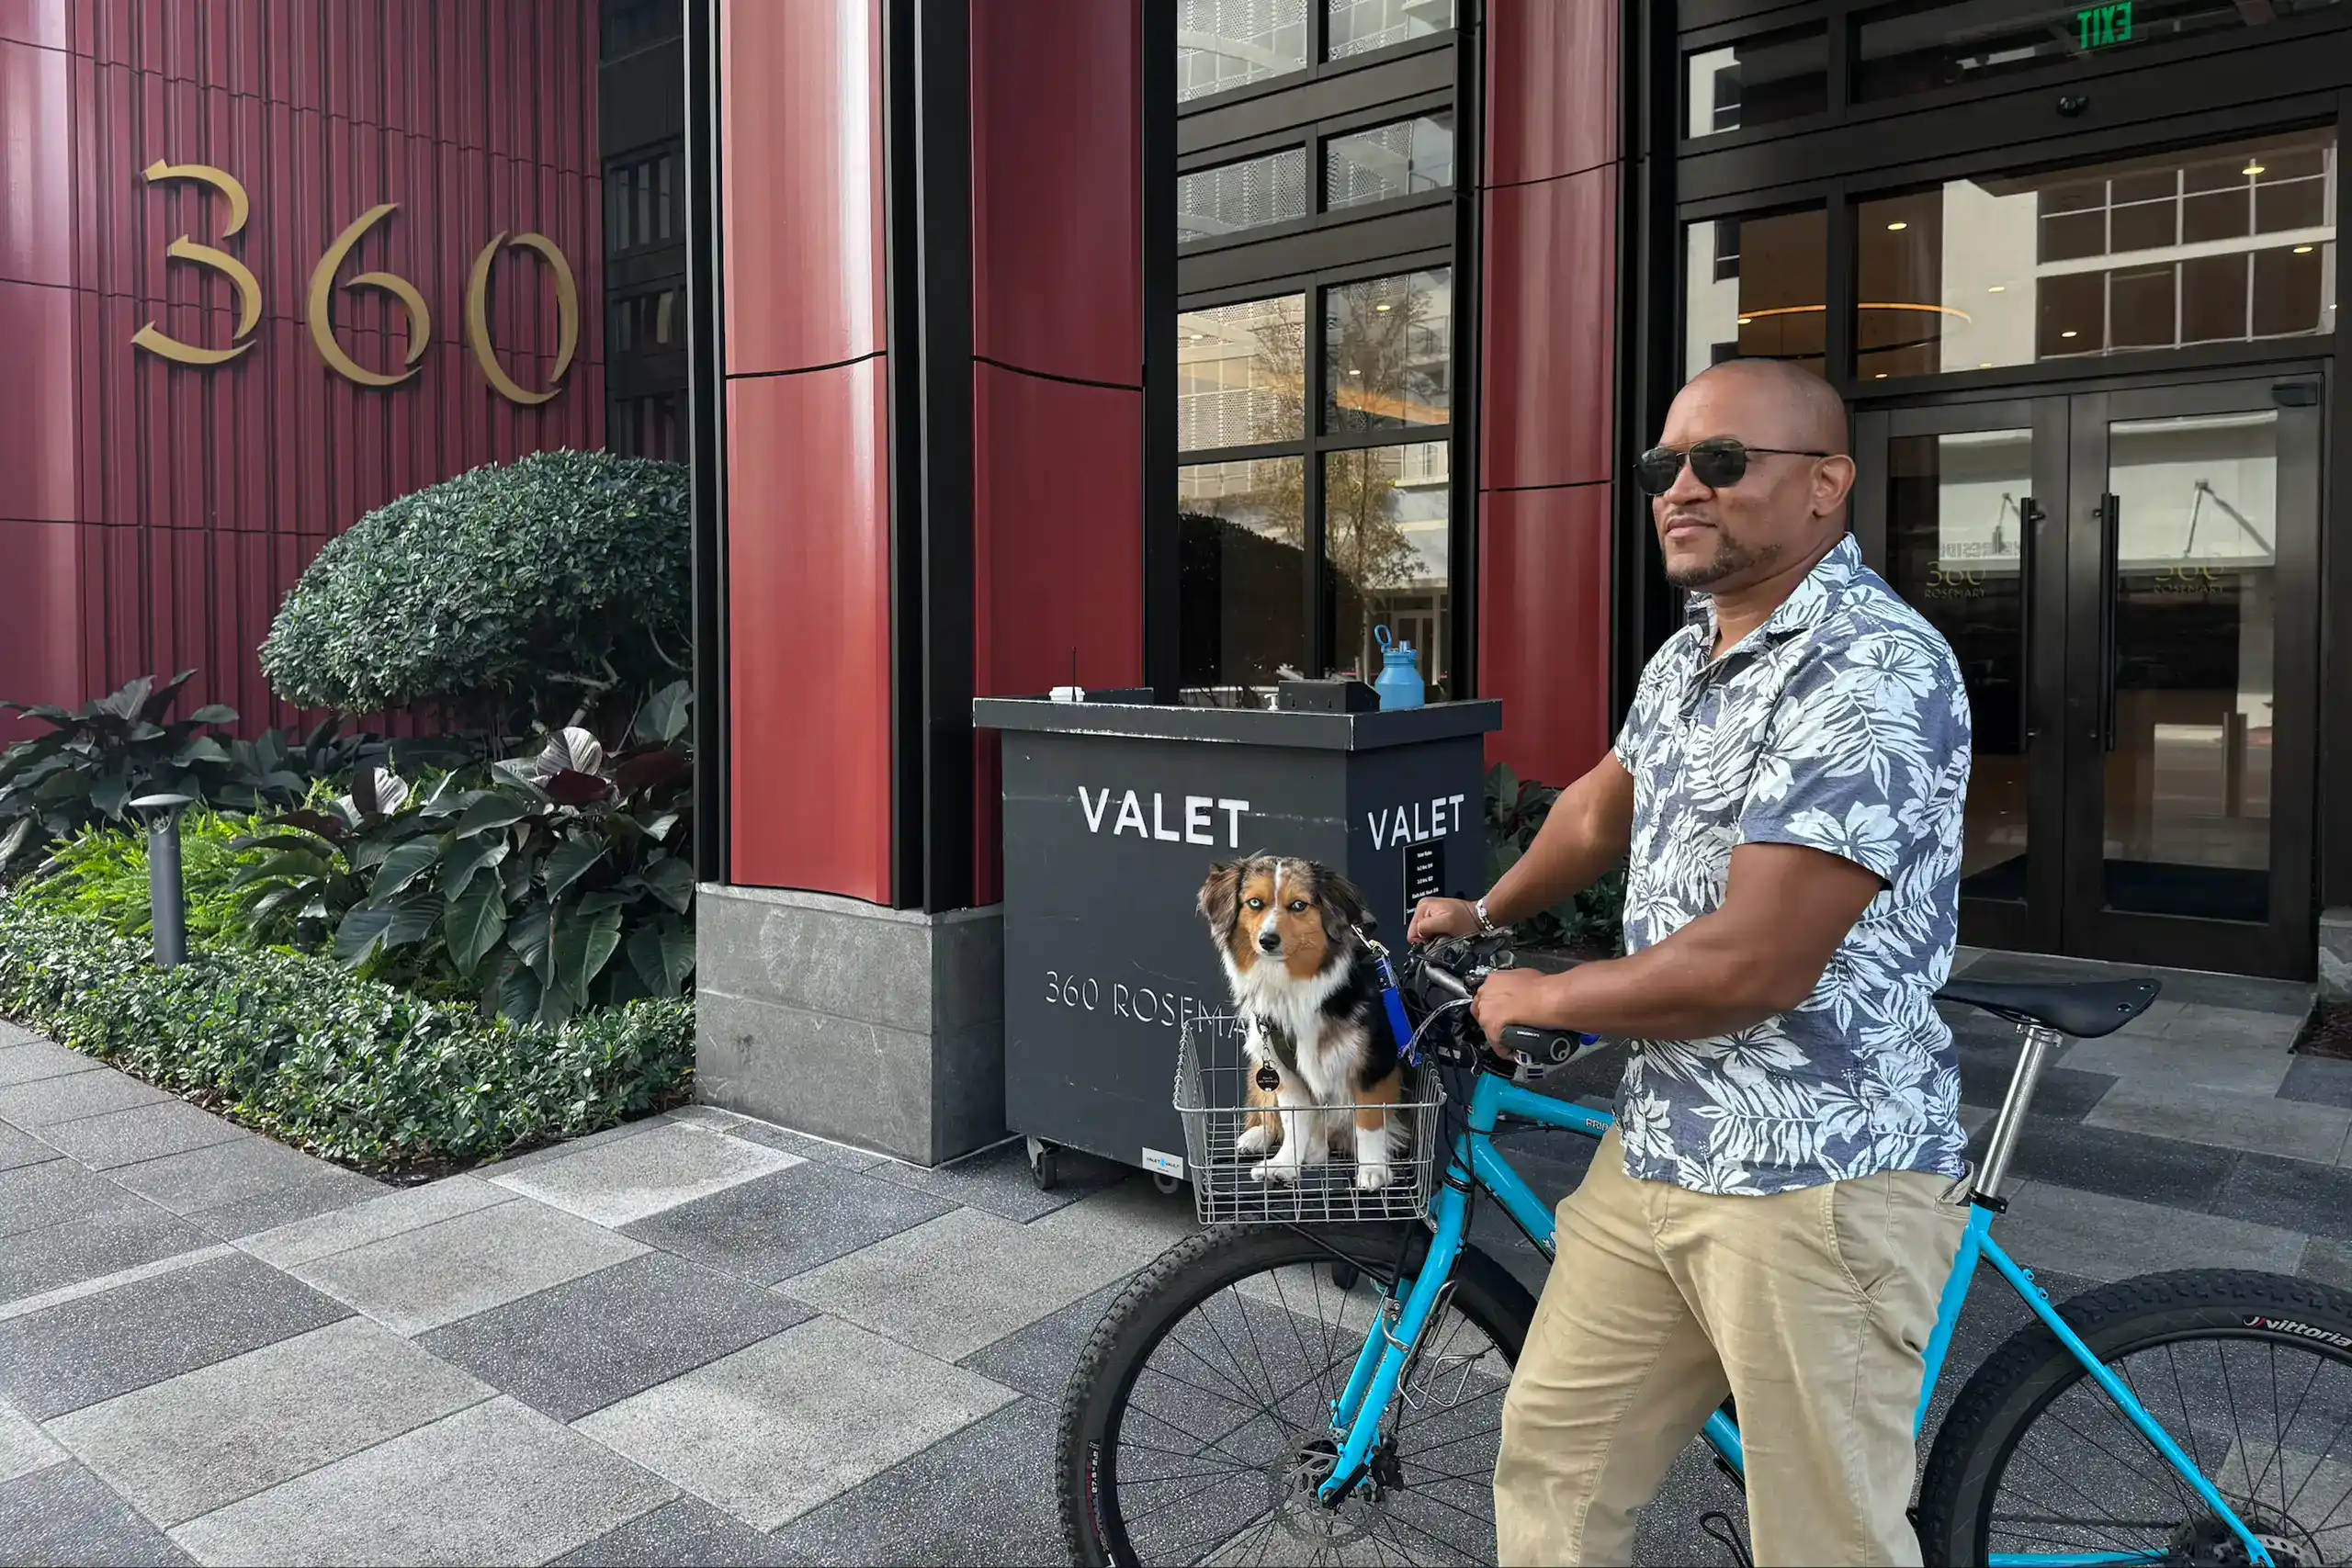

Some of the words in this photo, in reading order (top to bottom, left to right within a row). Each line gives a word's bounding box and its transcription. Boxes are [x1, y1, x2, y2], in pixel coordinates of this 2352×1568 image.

[130, 158, 579, 405] 360
[1924, 588, 1985, 599] ROSEMARY
[1078, 785, 1250, 849] VALET
[1367, 793, 1464, 851] VALET
[1046, 970, 1100, 1010] 360
